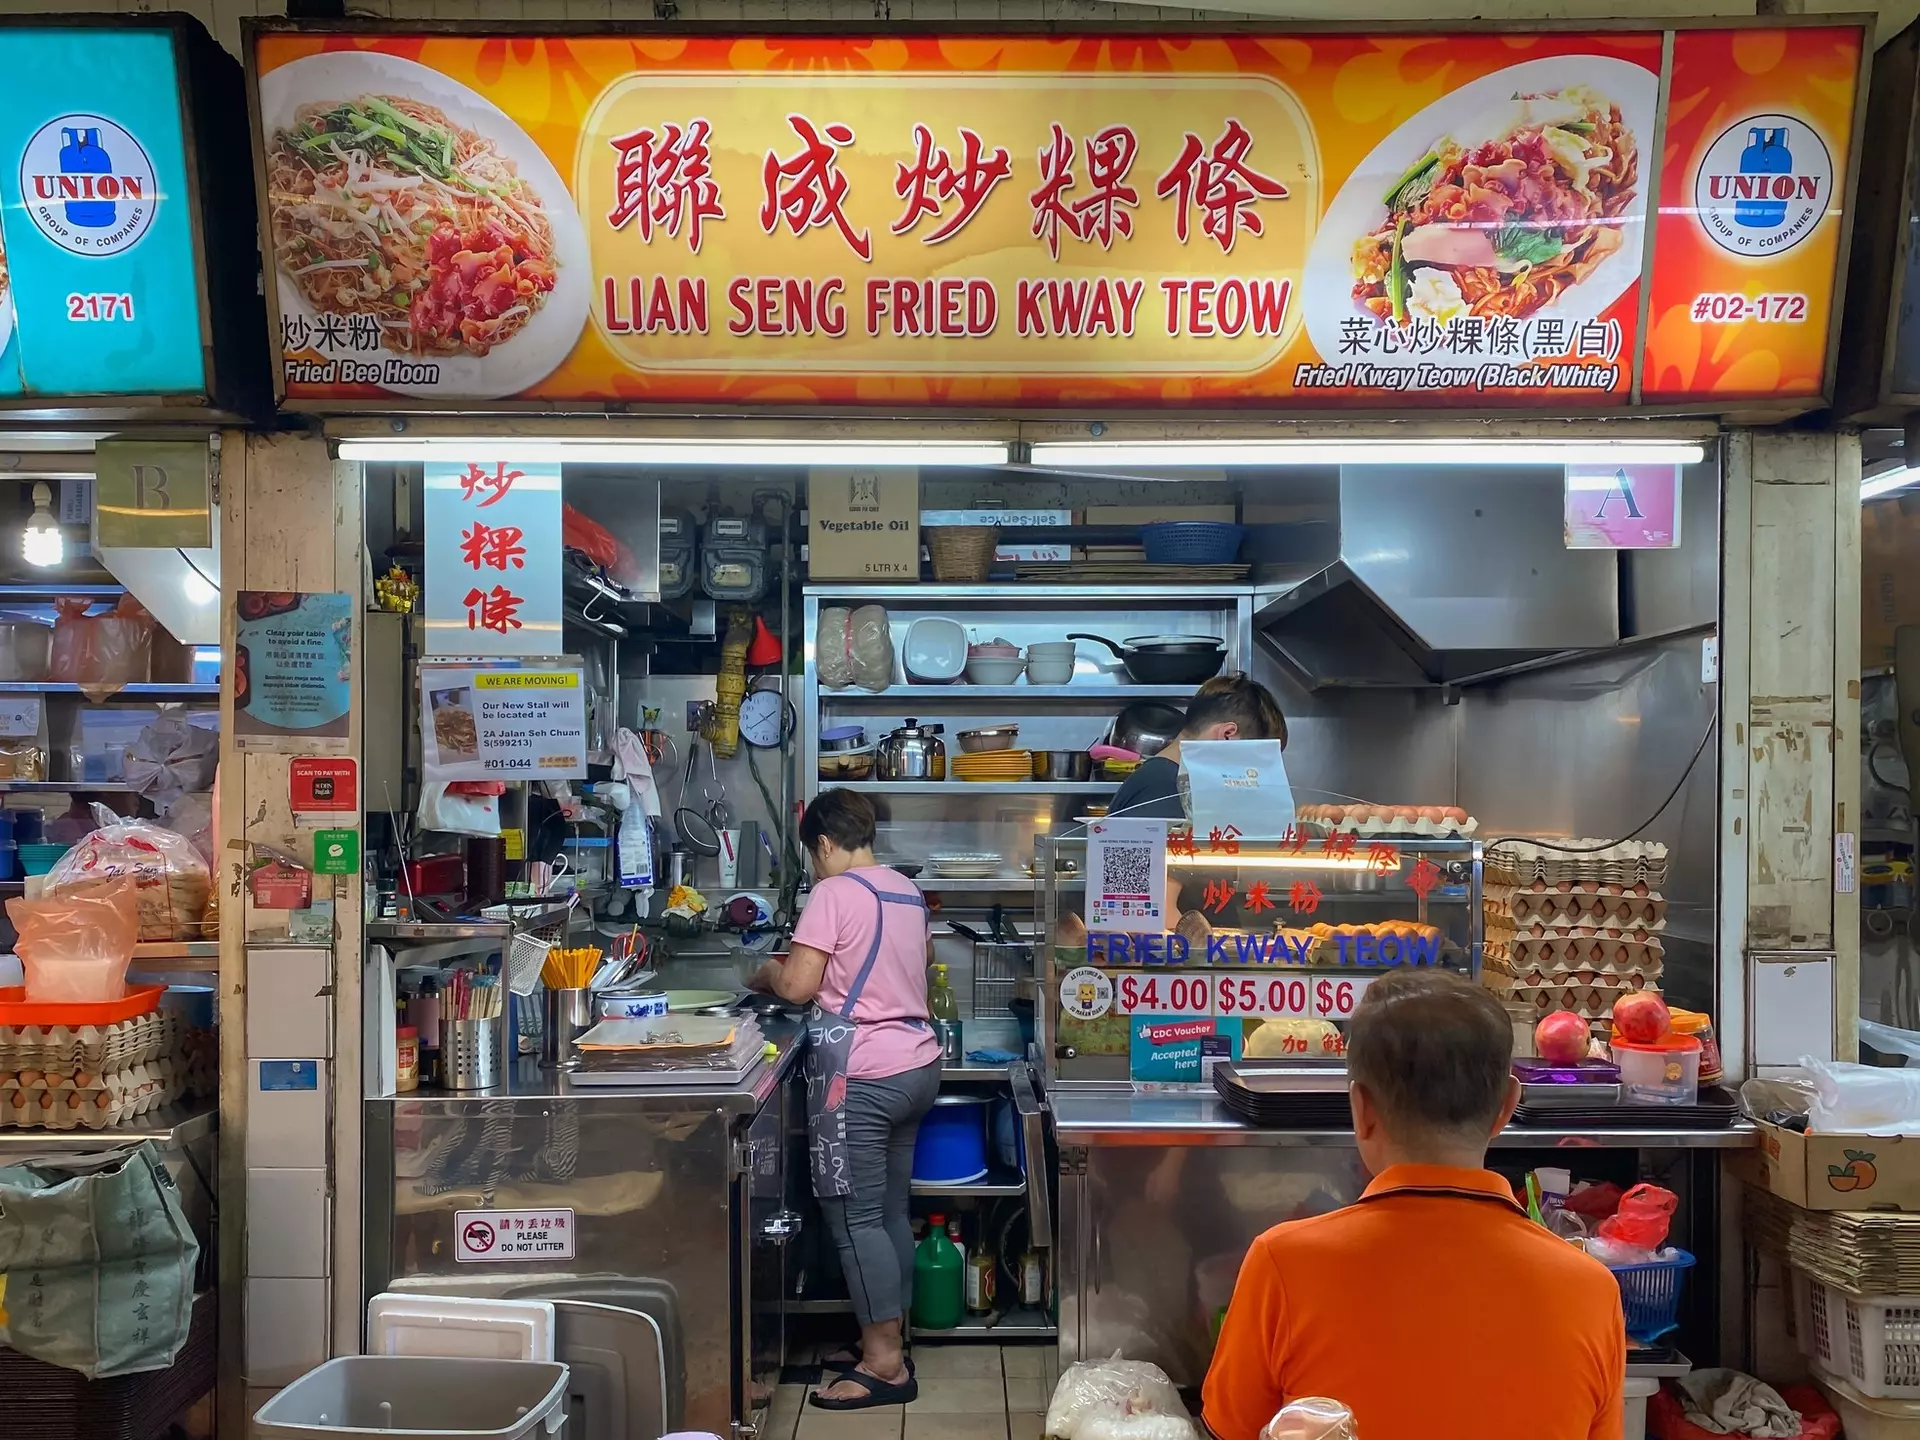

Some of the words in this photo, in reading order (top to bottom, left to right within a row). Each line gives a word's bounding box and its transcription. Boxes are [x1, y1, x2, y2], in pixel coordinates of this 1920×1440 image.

[32, 175, 143, 200] UNION
[607, 115, 1290, 260] 聯成炒粿條
[1708, 175, 1821, 200] UNION
[38, 206, 68, 237] GROUP
[75, 236, 89, 247] OF
[96, 206, 143, 247] COMPANIES
[1708, 206, 1733, 238] GROUP
[1738, 236, 1752, 247] OF
[1759, 206, 1813, 248] COMPANIES
[68, 295, 133, 319] 2171
[603, 275, 708, 334] LIAN
[727, 276, 848, 336] SENG
[866, 278, 997, 337] FRIED
[1017, 278, 1145, 337] KWAY
[1160, 278, 1291, 338] TEOW
[1693, 296, 1806, 320] #02-172
[280, 313, 382, 352] 炒米粉
[1338, 316, 1623, 359] 菜心炒粿條(黑/白)
[284, 360, 337, 384] Fried
[340, 360, 381, 384] Bee
[384, 360, 440, 384] Hoon
[1294, 364, 1351, 388] Fried
[1351, 364, 1414, 391] Kway
[1417, 365, 1477, 388] Teow
[1477, 364, 1619, 392] (Black/White)
[132, 465, 172, 509] B
[1592, 467, 1647, 519] A
[819, 520, 884, 533] Vegetable
[889, 519, 910, 531] Oil
[979, 514, 1057, 527] Self-Service
[459, 461, 527, 635] 炒粿條
[865, 563, 871, 573] 5
[873, 563, 891, 572] LTR
[893, 563, 901, 572] X
[902, 563, 908, 572] 4
[265, 629, 285, 637] Clear
[486, 677, 501, 686] WE
[503, 676, 521, 686] ARE
[524, 675, 568, 685] MOVING!
[482, 701, 500, 710] Our
[502, 701, 524, 709] New
[527, 700, 550, 709] Stall
[551, 700, 570, 709] will
[482, 710, 495, 719] be
[497, 709, 534, 719] located
[536, 711, 547, 719] at
[483, 730, 496, 738] 2A
[498, 730, 525, 738] Jalan
[528, 729, 547, 737] Seh
[549, 729, 580, 737] Chuan
[483, 738, 533, 748] S(599213)
[484, 758, 532, 768] #01-044
[104, 864, 126, 878] Tai
[1203, 878, 1325, 915] 炒米粉
[1086, 933, 1190, 964] FRIED
[1206, 934, 1314, 966] KWAY
[1333, 935, 1441, 966] TEOW
[1076, 970, 1097, 978] FEATURED
[1121, 976, 1208, 1013] $4.00
[1218, 977, 1306, 1015] $5.00
[1152, 1028, 1173, 1041] CDC
[1174, 1024, 1211, 1038] Voucher
[1151, 1047, 1198, 1062] Accepted
[1174, 1059, 1198, 1070] here
[828, 1141, 852, 1196] LOVE
[501, 1243, 514, 1252] DO
[516, 1243, 533, 1252] NOT
[536, 1242, 565, 1251] LITTER
[517, 1231, 548, 1240] PLEASE
